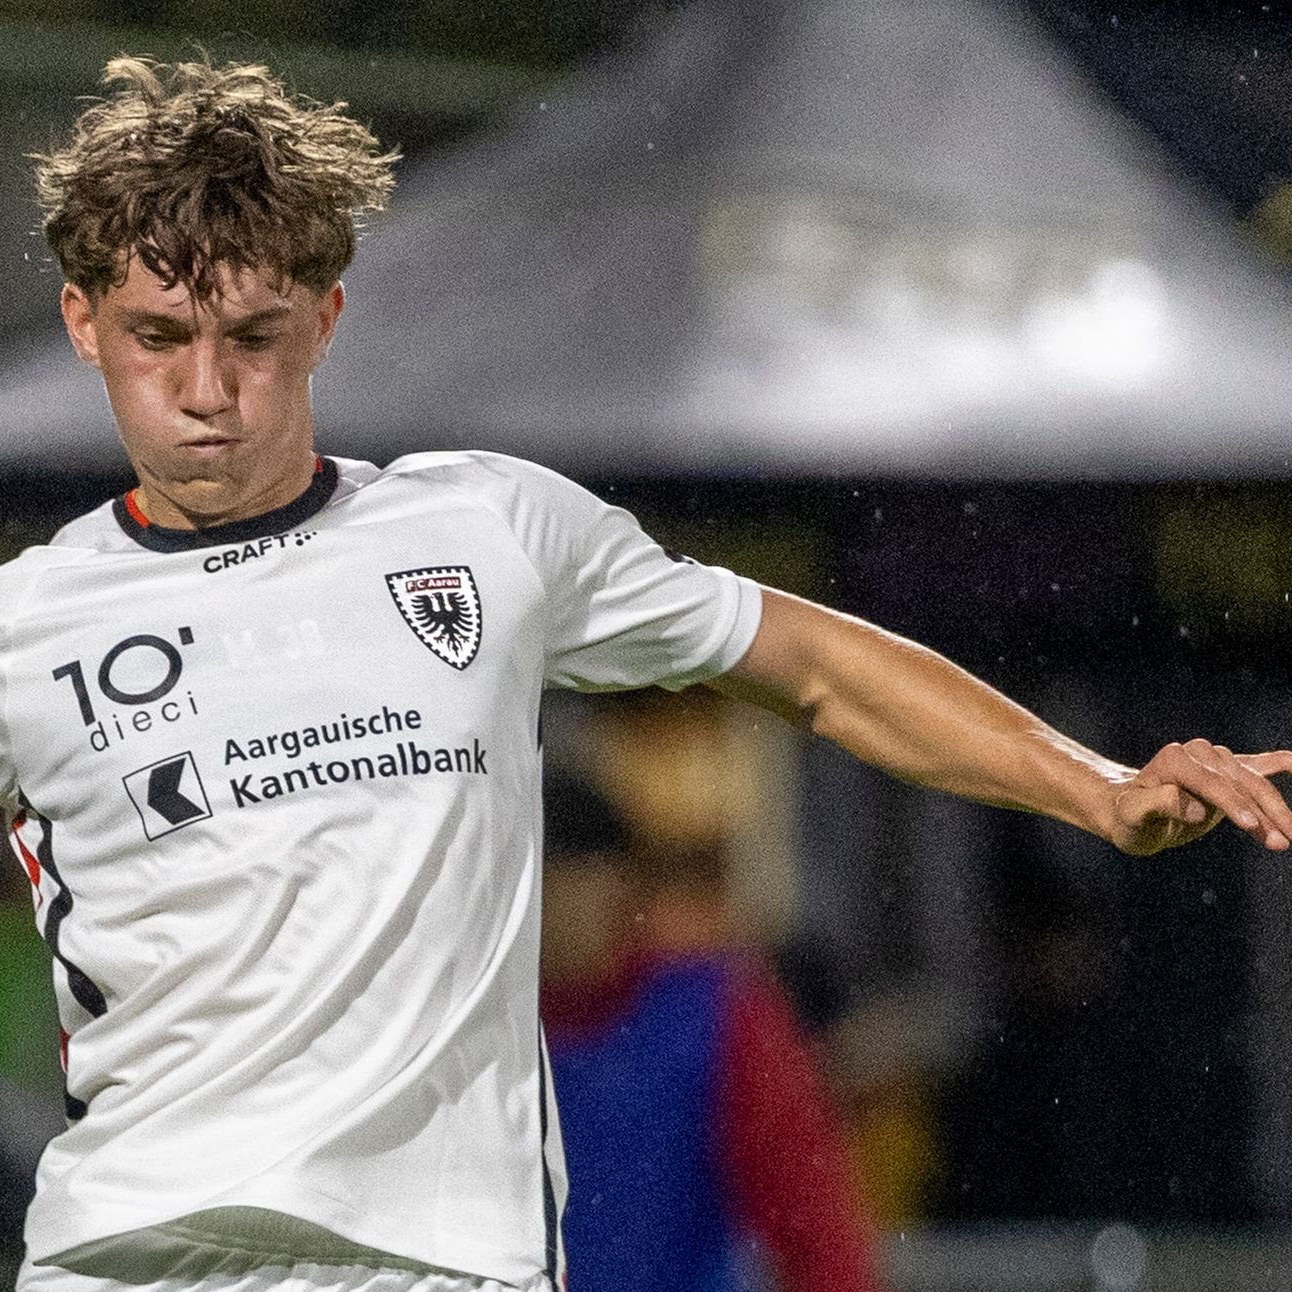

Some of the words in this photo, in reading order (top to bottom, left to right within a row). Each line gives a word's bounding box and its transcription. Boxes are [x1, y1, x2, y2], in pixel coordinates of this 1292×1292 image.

[202, 533, 290, 574] CRAFT
[406, 579, 426, 591] FC
[427, 577, 460, 588] Aarau
[90, 690, 198, 752] dieci
[224, 705, 422, 766] Aargauische
[229, 737, 488, 809] Kantonalbank
